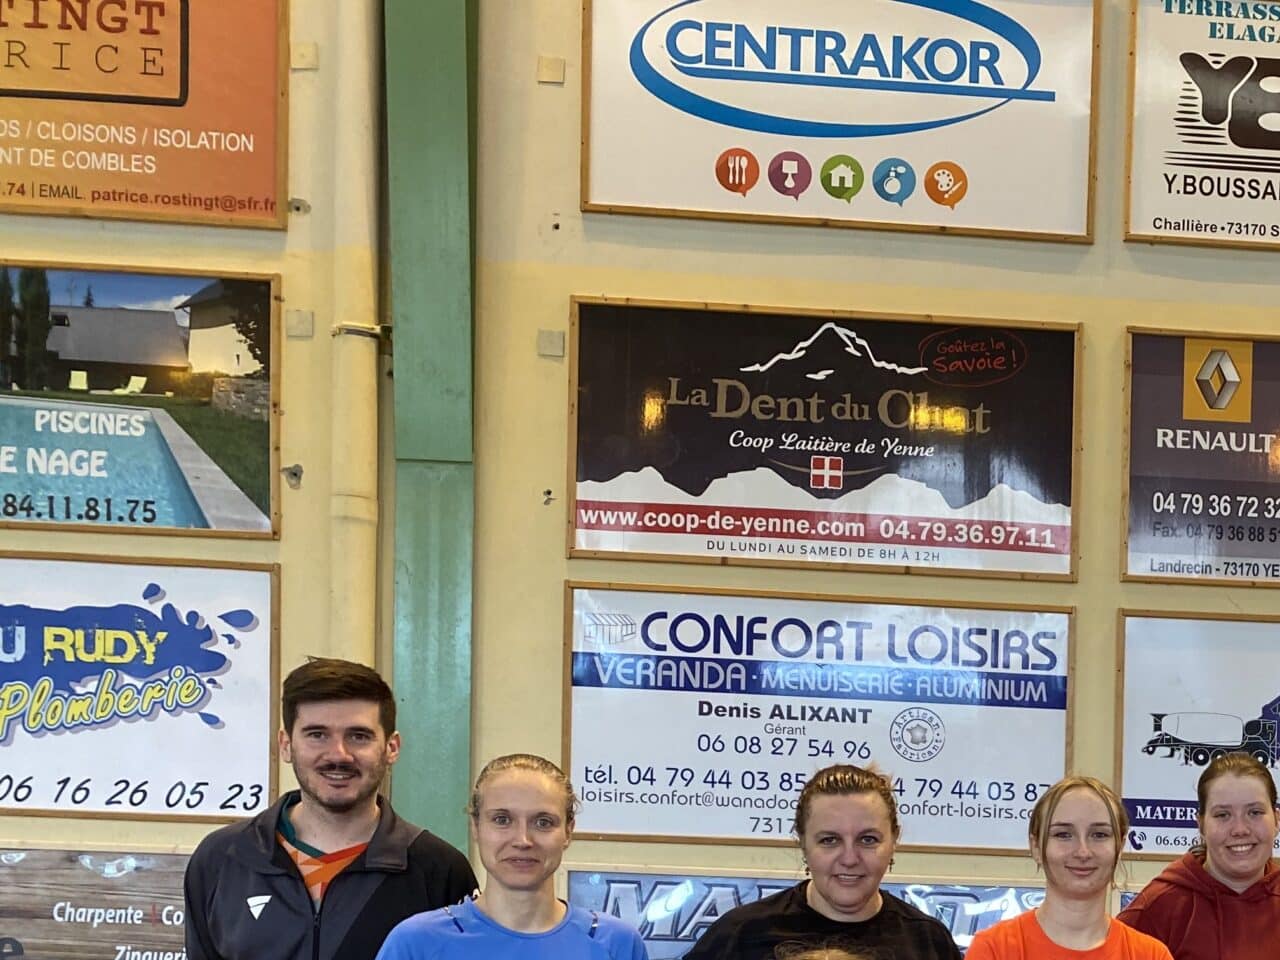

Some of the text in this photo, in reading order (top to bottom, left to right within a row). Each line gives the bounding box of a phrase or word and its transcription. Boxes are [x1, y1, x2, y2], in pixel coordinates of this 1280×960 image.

[665, 19, 1004, 86] CENTRAKOR
[37, 121, 136, 145] CLOISONS
[153, 129, 254, 152] ISOLATION
[30, 148, 156, 173] DE COMBLES
[91, 188, 276, 212] patrice.rostingt@sfr.fr
[1152, 217, 1218, 233] Challière
[933, 352, 1006, 373] Savoie
[667, 377, 710, 407] La
[709, 378, 826, 422] Dent
[831, 393, 872, 421] du
[34, 409, 146, 437] PISCINES
[729, 430, 934, 457] Coop Laitière de Yenne
[1156, 428, 1276, 454] RENAULT
[26, 447, 108, 478] NAGE
[1153, 492, 1176, 514] 04
[1181, 494, 1202, 515] 79
[1208, 495, 1231, 516] 36
[1237, 497, 1259, 518] 72
[580, 508, 1055, 548] www.coop-de-yenne.com 04.79.36.97.11
[1186, 523, 1203, 538] 04
[1207, 525, 1223, 540] 79
[1228, 526, 1244, 541] 36
[1248, 527, 1264, 542] 88
[707, 541, 725, 550] DU
[730, 542, 772, 553] LUNDI
[777, 544, 795, 554] AU
[800, 545, 852, 557] SAMEDI
[857, 548, 874, 558] DE
[880, 549, 896, 559] 8H
[915, 551, 940, 561] 12H
[1150, 559, 1212, 575] Landrecin
[1224, 562, 1259, 577] 73170
[43, 626, 168, 667] RUDY
[640, 611, 1058, 671] CONFORT LOISIRS
[594, 656, 1047, 702] VERANDA MENUISERIE ALUMINIUM
[0, 668, 203, 740] Plomberie
[698, 700, 872, 724] Denis ALIXANT
[764, 723, 806, 736] Gérant
[697, 734, 871, 759] 06 08 27 54 96
[585, 765, 806, 792] tél. 04 79 44 03 85
[53, 776, 91, 803] 16
[105, 779, 149, 806] 26
[165, 781, 209, 808] 05
[219, 783, 263, 810] 23
[53, 902, 143, 928] Charpente
